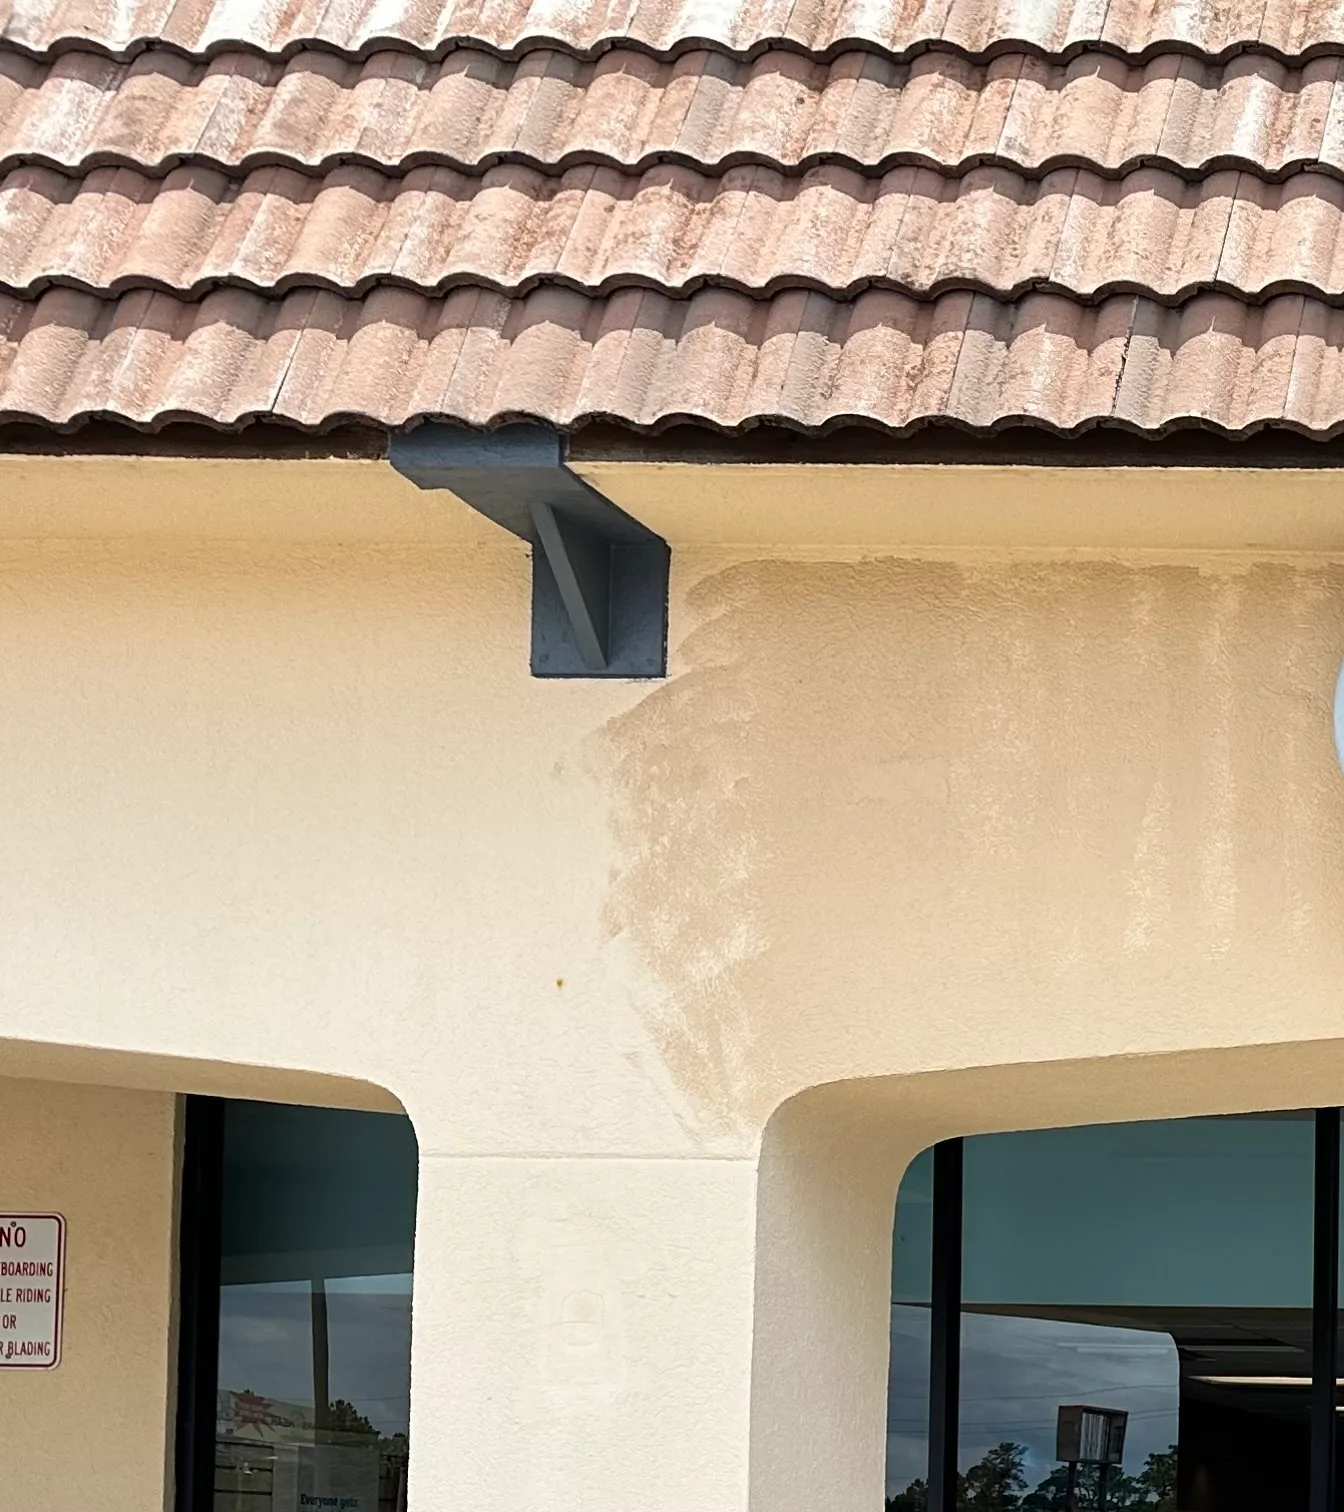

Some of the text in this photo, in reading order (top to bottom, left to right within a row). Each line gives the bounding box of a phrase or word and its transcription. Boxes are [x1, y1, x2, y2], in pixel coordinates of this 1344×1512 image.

[0, 1226, 27, 1248] NO
[0, 1261, 54, 1277] BOARDING
[15, 1288, 51, 1303] RIDING
[2, 1313, 17, 1329] OR
[8, 1341, 51, 1356] BLADING
